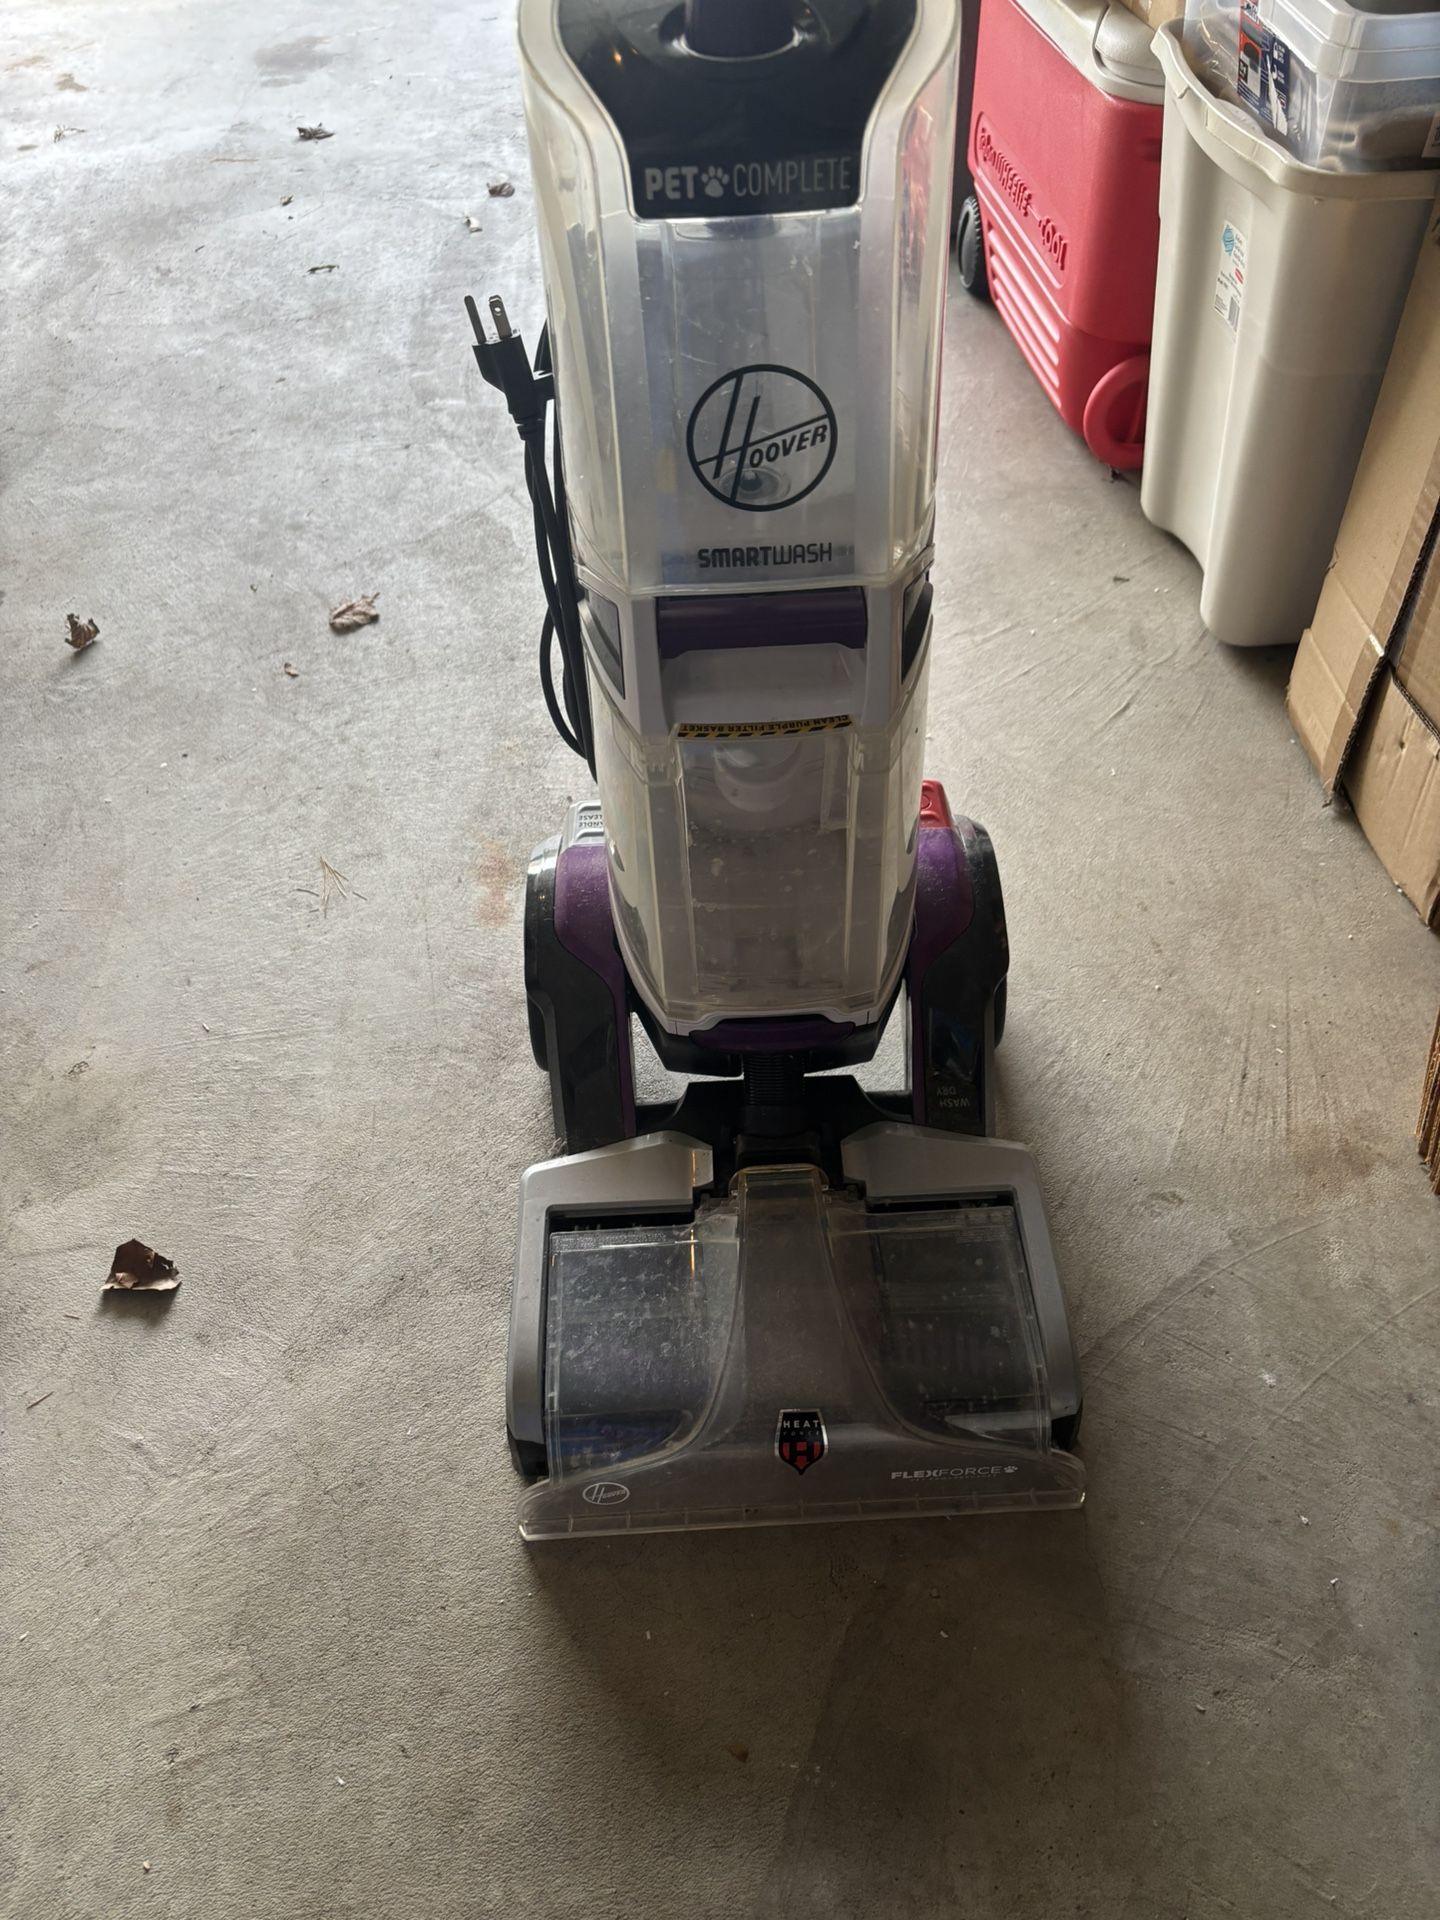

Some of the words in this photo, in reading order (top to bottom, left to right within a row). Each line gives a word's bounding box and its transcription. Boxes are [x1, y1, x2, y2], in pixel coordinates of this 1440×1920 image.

[644, 166, 698, 200] PET
[733, 157, 851, 197] COMPLETE
[695, 369, 831, 506] HOOVER
[698, 542, 832, 568] SMARTWASH
[767, 720, 809, 731] PURPLE
[812, 714, 849, 726] CLEAN
[682, 724, 723, 732] BASKET
[727, 724, 763, 733] FILTER
[939, 1097, 971, 1107] WASH
[783, 1420, 819, 1429] HEAT
[891, 1465, 1002, 1479] FLEXFORCE
